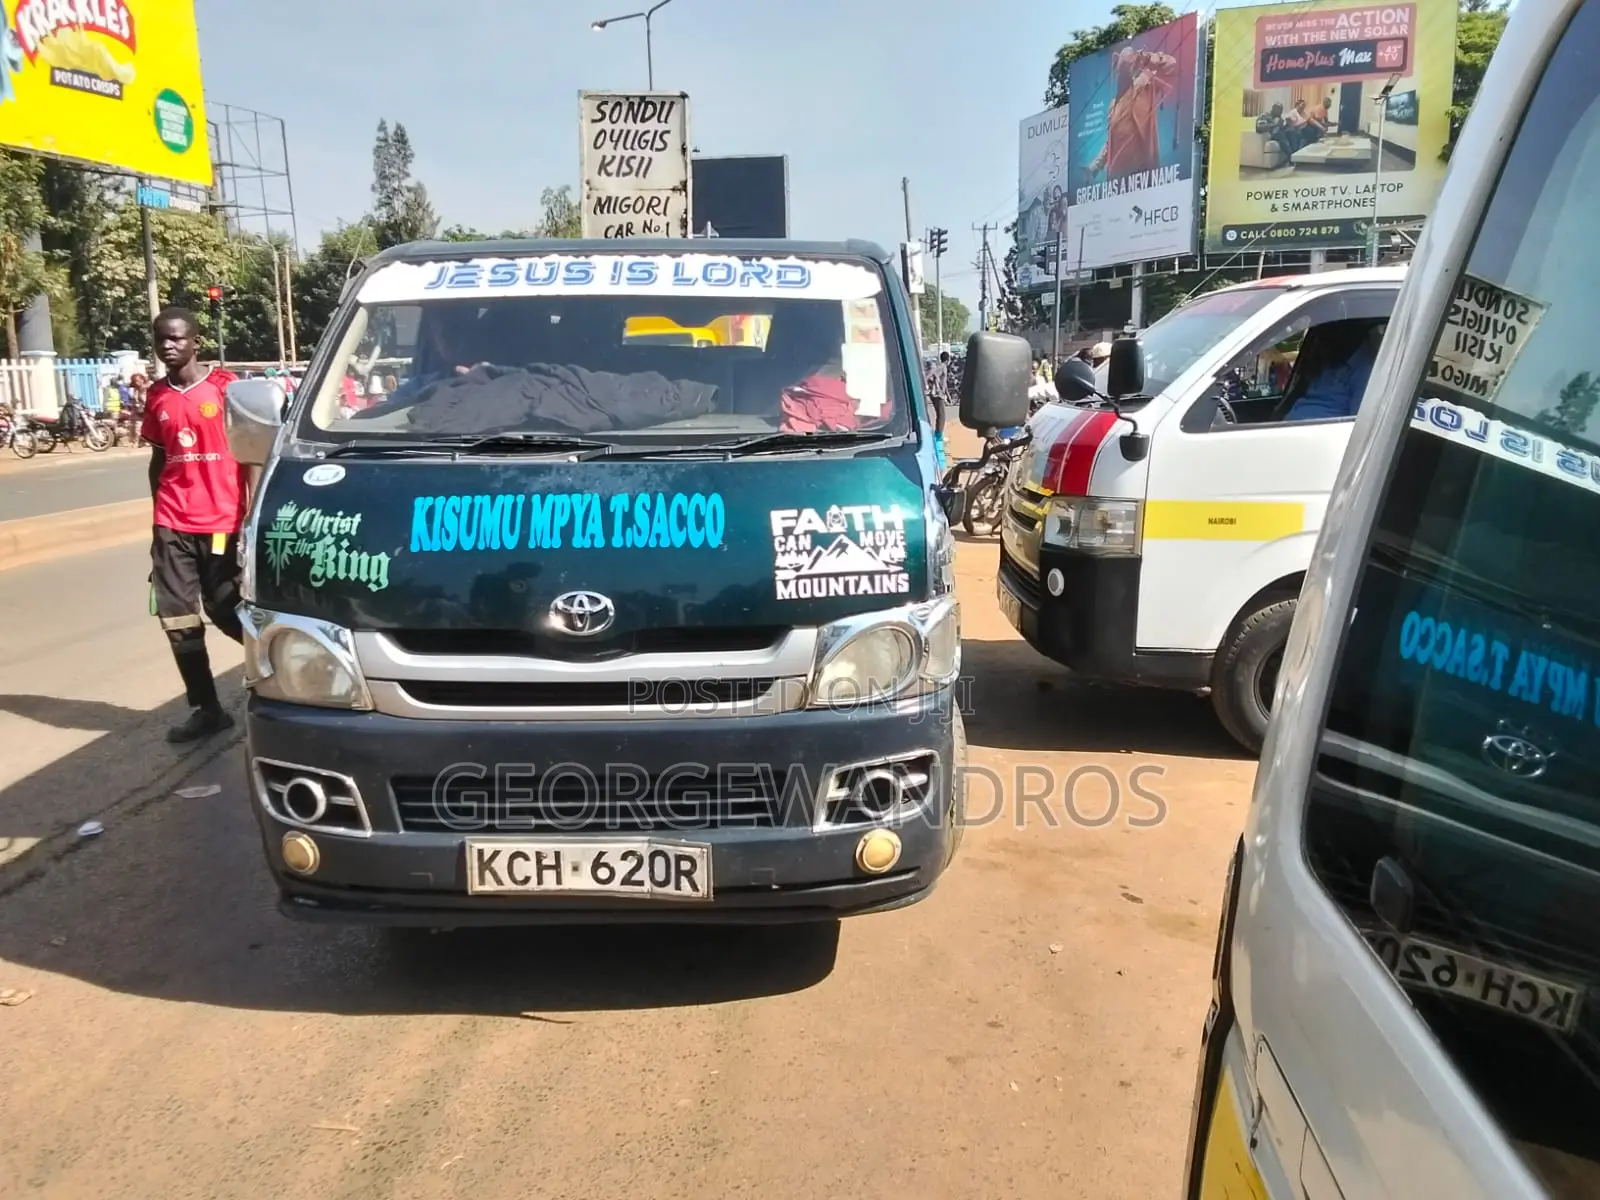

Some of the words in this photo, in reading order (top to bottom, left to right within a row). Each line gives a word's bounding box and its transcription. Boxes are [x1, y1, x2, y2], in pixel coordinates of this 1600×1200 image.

[1335, 8, 1409, 29] ACTION
[1265, 34, 1299, 46] WITH
[1302, 30, 1327, 42] THE
[1330, 27, 1361, 40] NEW
[1364, 24, 1409, 37] SOLAR
[1266, 51, 1336, 73] HomePlus
[1338, 48, 1373, 67] Max
[54, 70, 90, 89] POTATO
[91, 81, 121, 97] CRISPS
[591, 100, 675, 124] SONDU
[593, 128, 671, 152] OYUGIS
[597, 155, 652, 179] KISII
[1076, 183, 1101, 205] GREAT
[1102, 178, 1119, 199] HAS
[1119, 178, 1128, 194] A
[1128, 170, 1150, 192] NEW
[1151, 163, 1181, 188] NAME
[1246, 190, 1288, 200] POWER
[1293, 187, 1327, 198] YOUR
[593, 196, 670, 217] MIGORI
[1144, 205, 1179, 226] HFCB
[1270, 203, 1278, 213] &
[1283, 197, 1376, 212] SMARTPHONES
[604, 222, 636, 239] CAR
[1240, 230, 1267, 239] CALL
[1270, 228, 1296, 238] 0800
[1299, 227, 1318, 236] 724
[424, 260, 596, 290] JESUS
[610, 260, 659, 287] IS
[673, 260, 812, 290] LORD
[295, 507, 362, 538] Christ
[410, 494, 525, 552] KISUMU
[528, 493, 605, 549] MPYA
[610, 492, 725, 548] T.SACCO
[1208, 517, 1237, 525] NAIROBI
[774, 534, 811, 552] CAN
[859, 530, 905, 547] MOVE
[294, 538, 314, 557] the
[310, 536, 391, 592] King
[775, 573, 909, 600] MOUNTAINS
[477, 848, 563, 888] KCH
[590, 849, 699, 893] 620R
